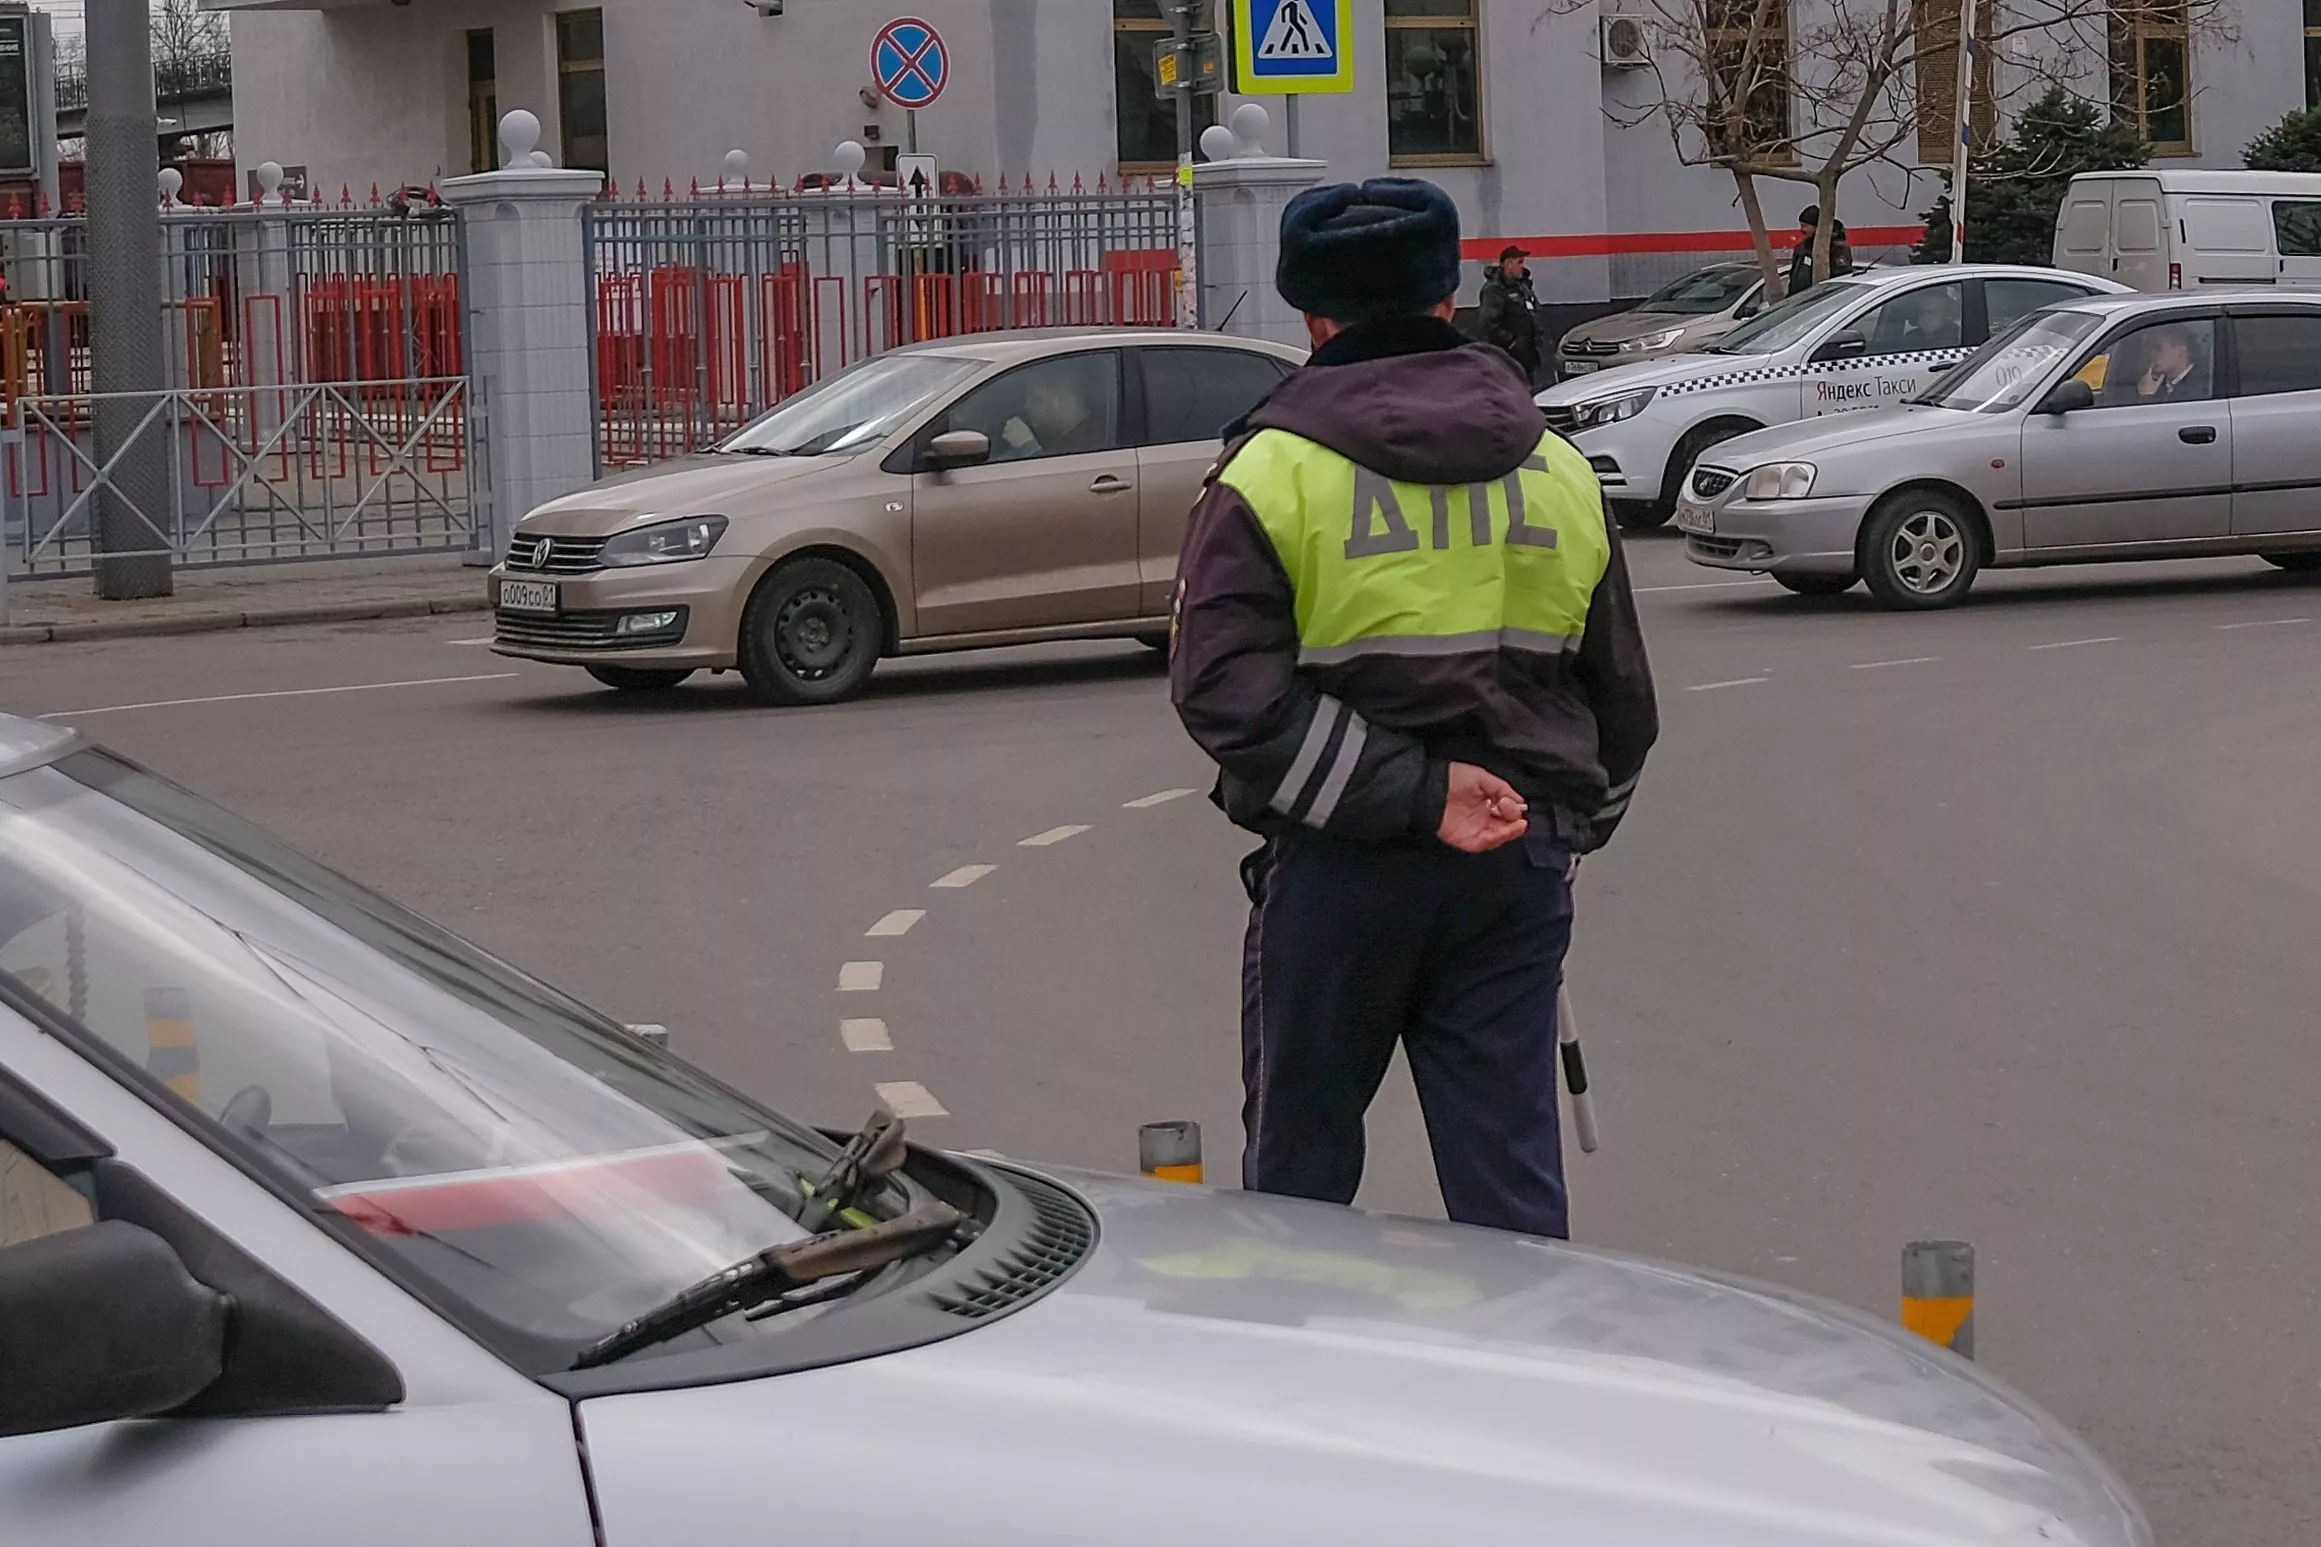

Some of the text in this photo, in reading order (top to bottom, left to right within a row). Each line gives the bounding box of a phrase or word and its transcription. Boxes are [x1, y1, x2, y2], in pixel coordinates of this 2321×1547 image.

[1817, 376, 1917, 402] Яндекс Такси
[1344, 455, 1558, 560] ДПС
